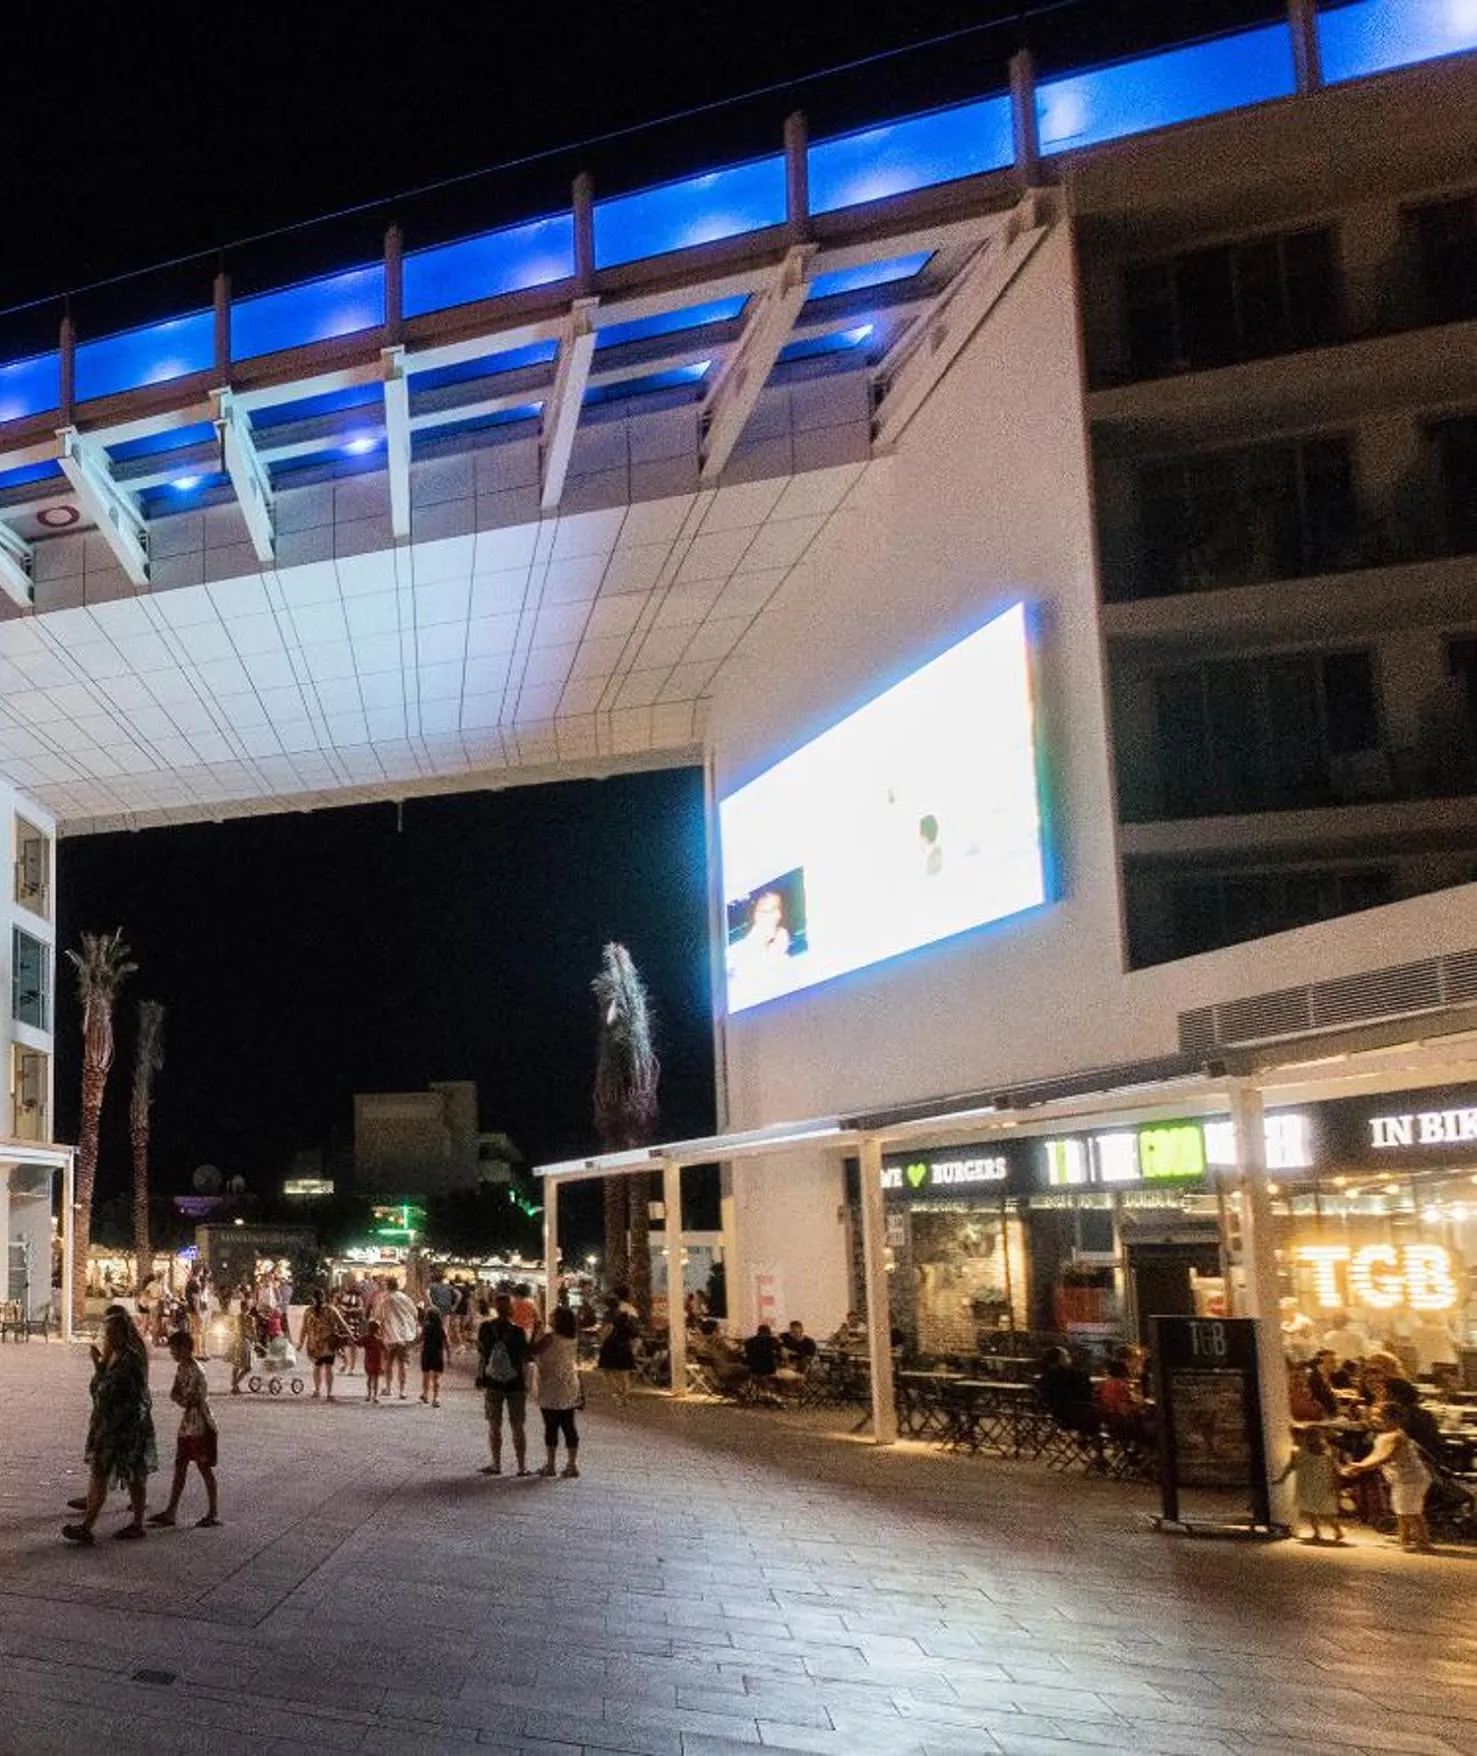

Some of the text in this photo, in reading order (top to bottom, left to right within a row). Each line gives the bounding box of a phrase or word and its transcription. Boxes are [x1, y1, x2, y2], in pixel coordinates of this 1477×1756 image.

[1369, 1115, 1413, 1147] IN
[931, 1157, 1006, 1184] BURGERS
[1295, 1244, 1457, 1310] TGB
[1188, 1321, 1226, 1356] TGB
